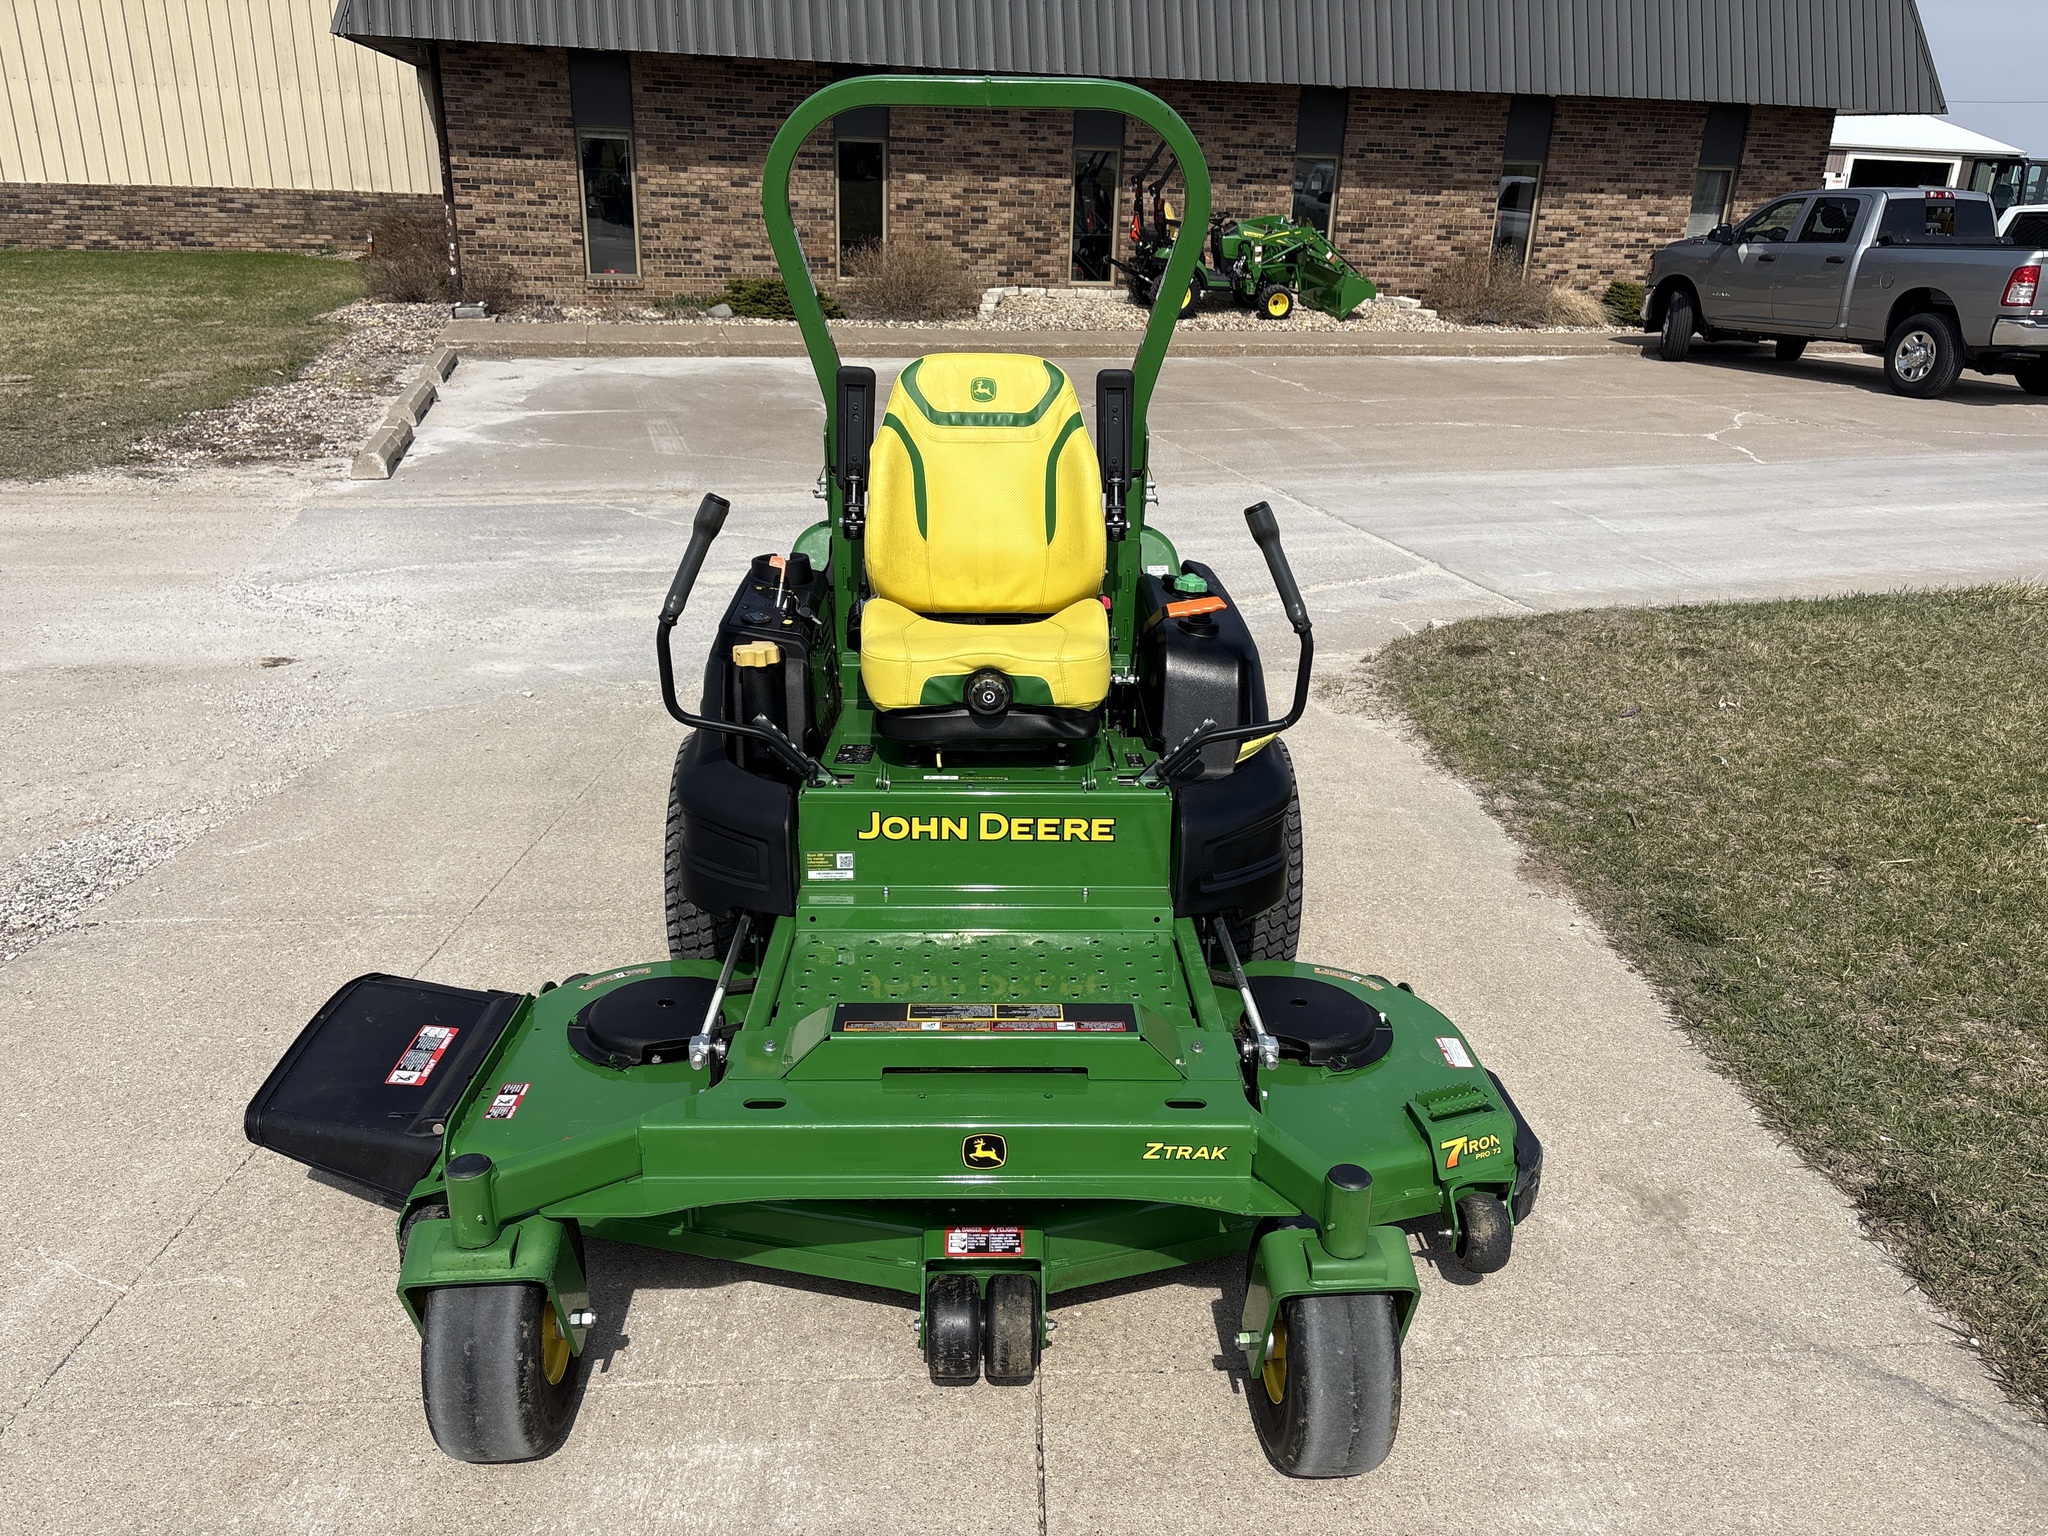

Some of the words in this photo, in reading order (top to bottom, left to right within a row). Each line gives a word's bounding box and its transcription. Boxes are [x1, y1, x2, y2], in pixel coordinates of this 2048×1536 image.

[858, 811, 969, 841] JOHN
[978, 812, 1115, 842] DEERE
[1143, 1142, 1230, 1160] ZTRAK
[1475, 1151, 1491, 1160] PRO
[1492, 1147, 1502, 1155] 72
